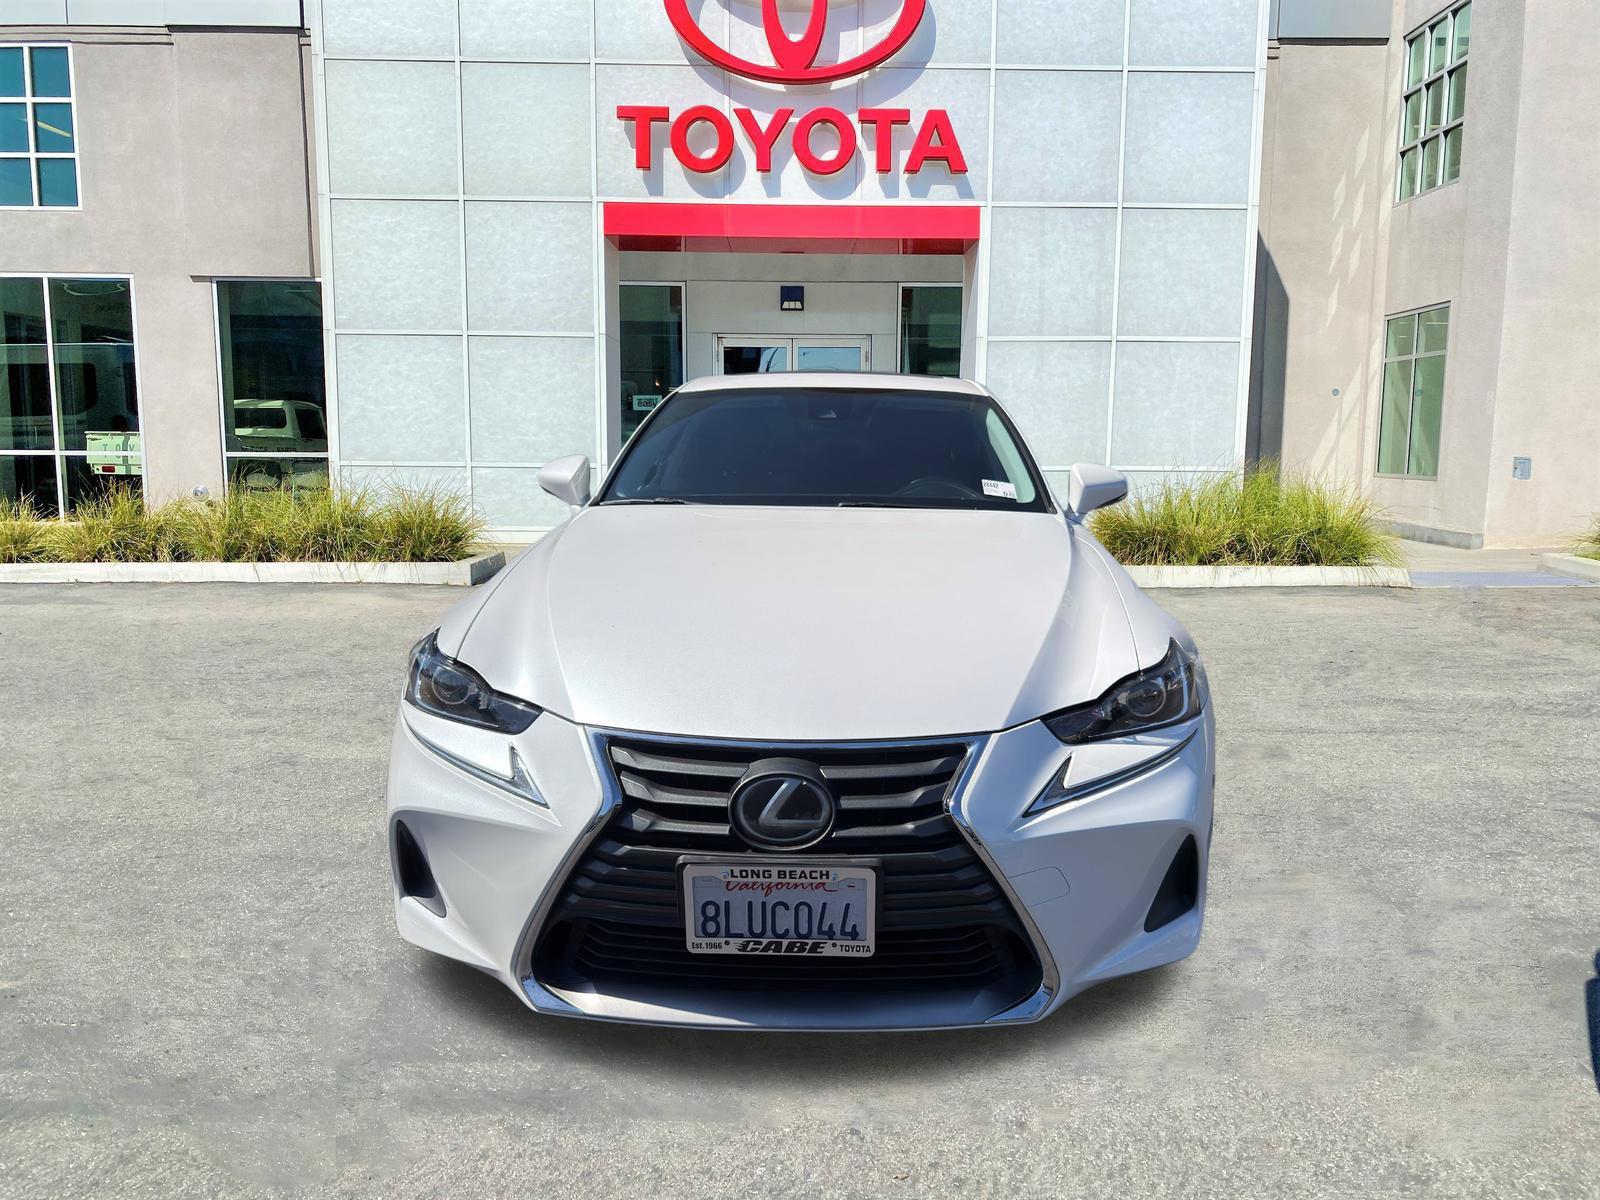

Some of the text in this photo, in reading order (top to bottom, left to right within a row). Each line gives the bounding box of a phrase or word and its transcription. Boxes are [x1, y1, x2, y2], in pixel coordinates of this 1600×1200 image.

[617, 104, 969, 175] TOYOTA
[730, 869, 830, 880] LONG BEACH
[725, 880, 838, 897] California
[700, 900, 860, 940] 8LUC044
[691, 941, 723, 950] Est. 1966
[738, 940, 828, 955] CABE
[839, 944, 872, 953] TOYOTA
